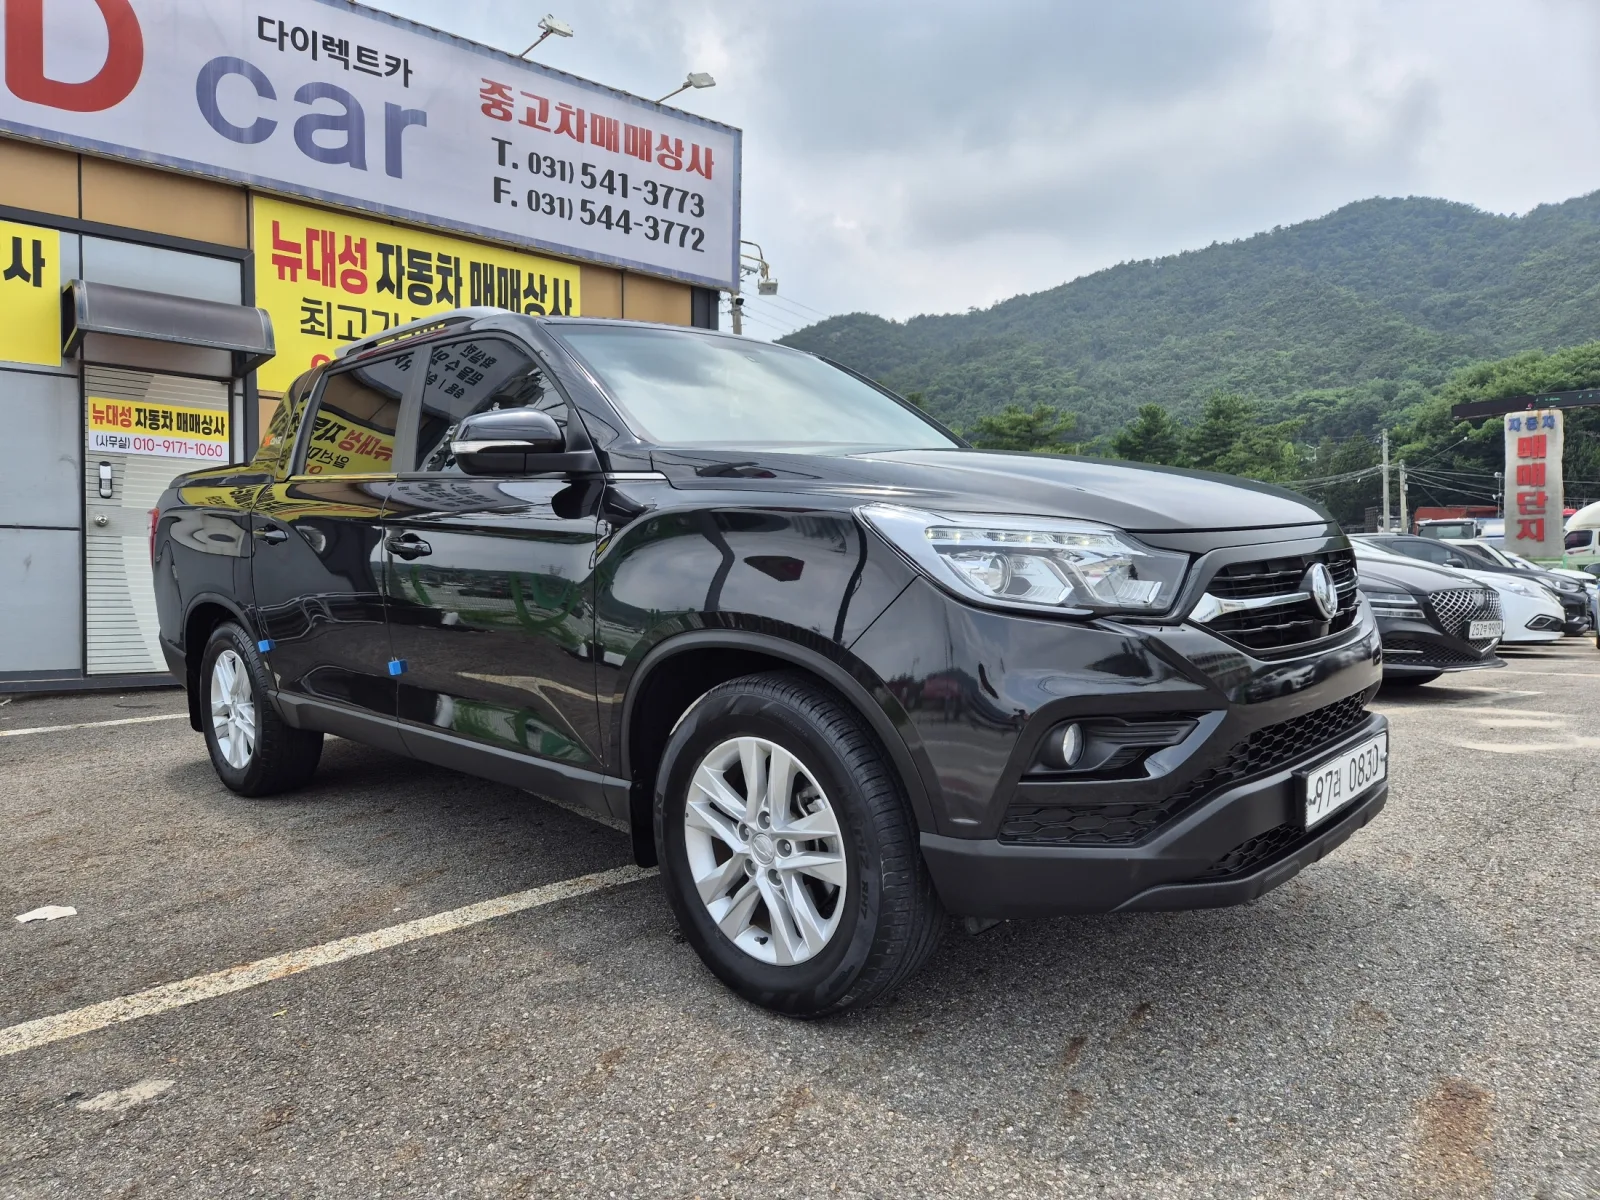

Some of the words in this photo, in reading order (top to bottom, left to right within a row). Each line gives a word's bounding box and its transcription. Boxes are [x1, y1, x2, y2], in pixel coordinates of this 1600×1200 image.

[5, 0, 144, 112] D
[195, 55, 428, 180] car
[257, 15, 413, 88] 다이렉트카
[479, 77, 714, 180] 중고차매매상사
[491, 136, 519, 170] T.
[527, 152, 575, 184] 031)
[580, 162, 705, 218] 541-3773
[493, 176, 518, 207] F.
[526, 189, 574, 220] 031)
[579, 198, 705, 253] 544-3772
[271, 220, 368, 295] 뉴대성
[376, 241, 463, 309] 자동차
[92, 403, 132, 428] 뉴대성
[134, 407, 174, 432] 자동차
[176, 412, 226, 436] 매매상사
[95, 434, 131, 449] (사무실)
[133, 437, 223, 457] 010-9171-1060
[1516, 433, 1549, 543] 매매단지
[1349, 744, 1379, 793] 0830
